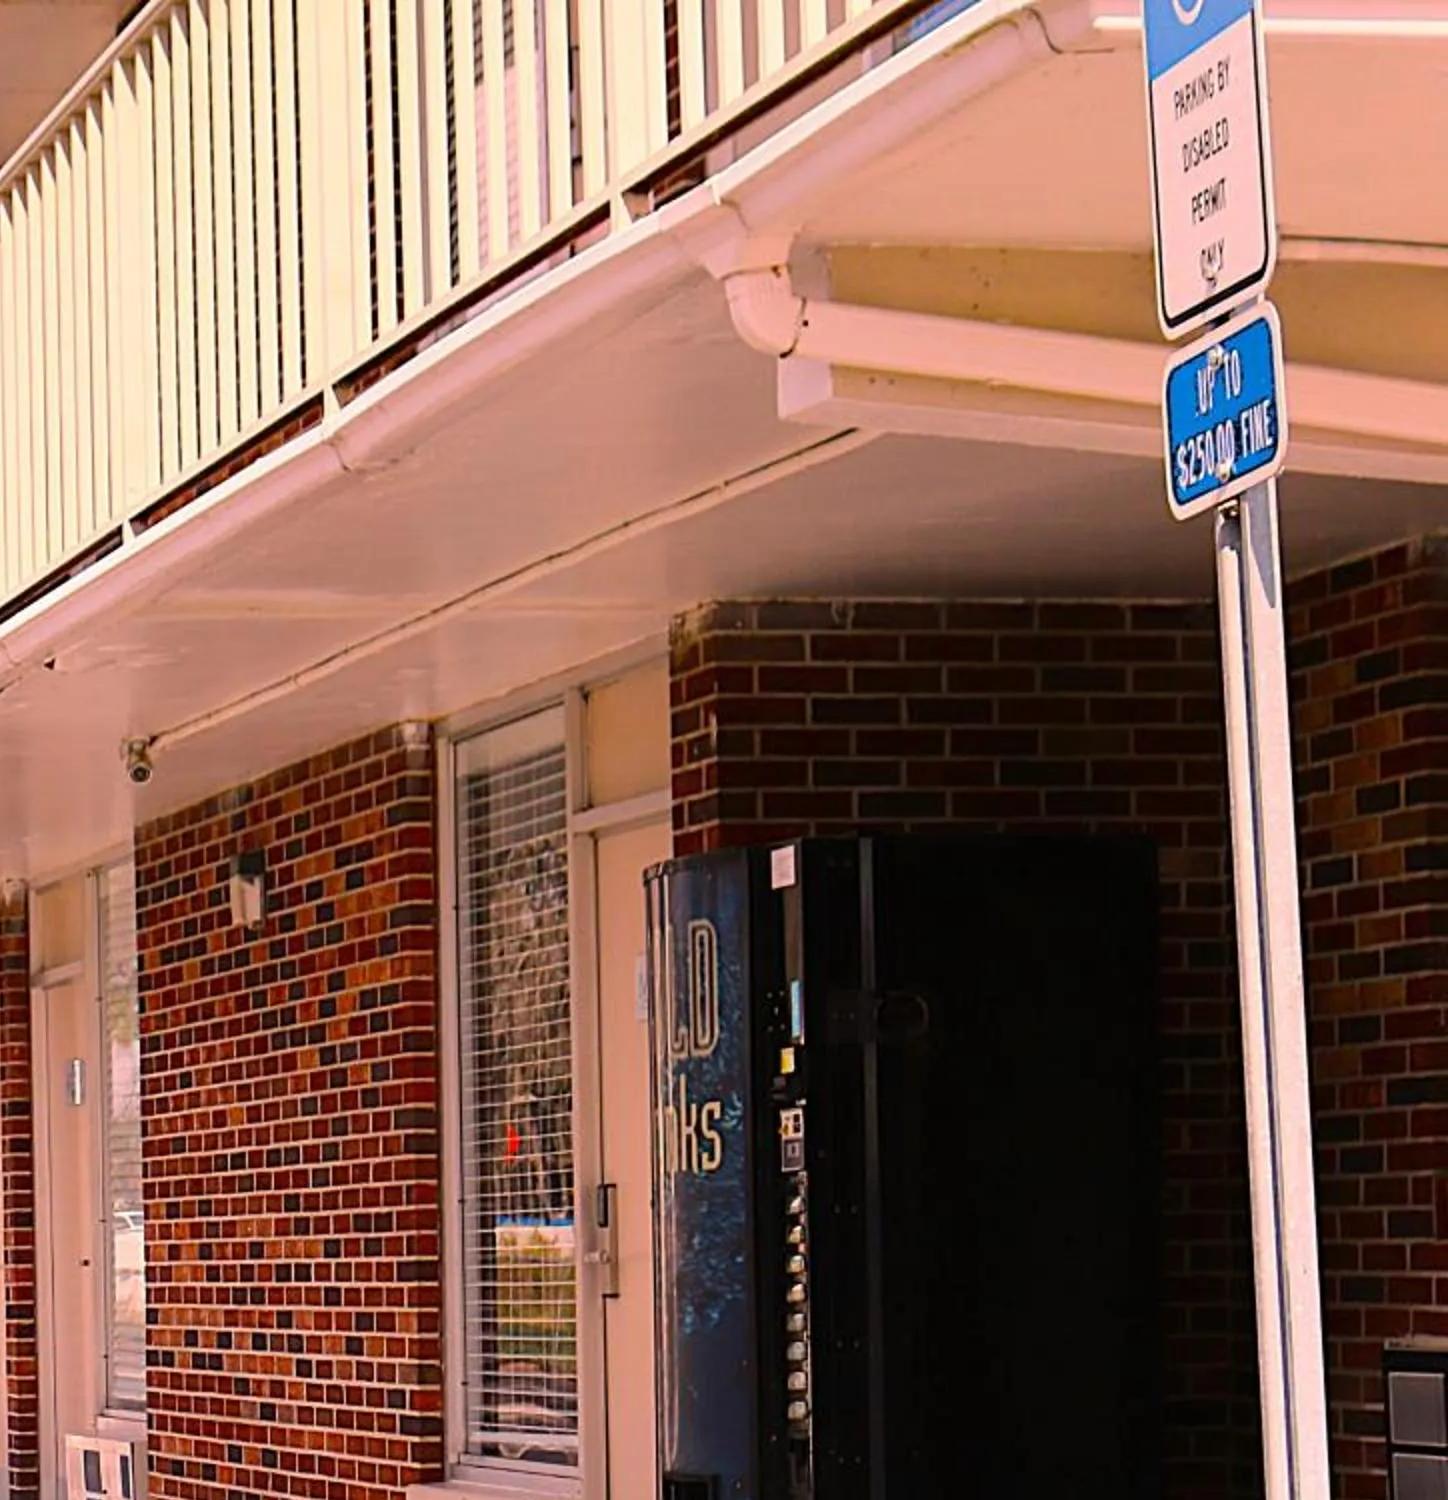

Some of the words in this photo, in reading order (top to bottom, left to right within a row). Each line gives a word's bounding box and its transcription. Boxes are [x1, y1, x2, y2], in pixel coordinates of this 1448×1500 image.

[1173, 67, 1215, 120] PARKING
[1217, 54, 1231, 95] BY
[1182, 117, 1230, 173] DISABLED
[1191, 177, 1227, 225] PERMIT
[1241, 399, 1273, 458] FINE
